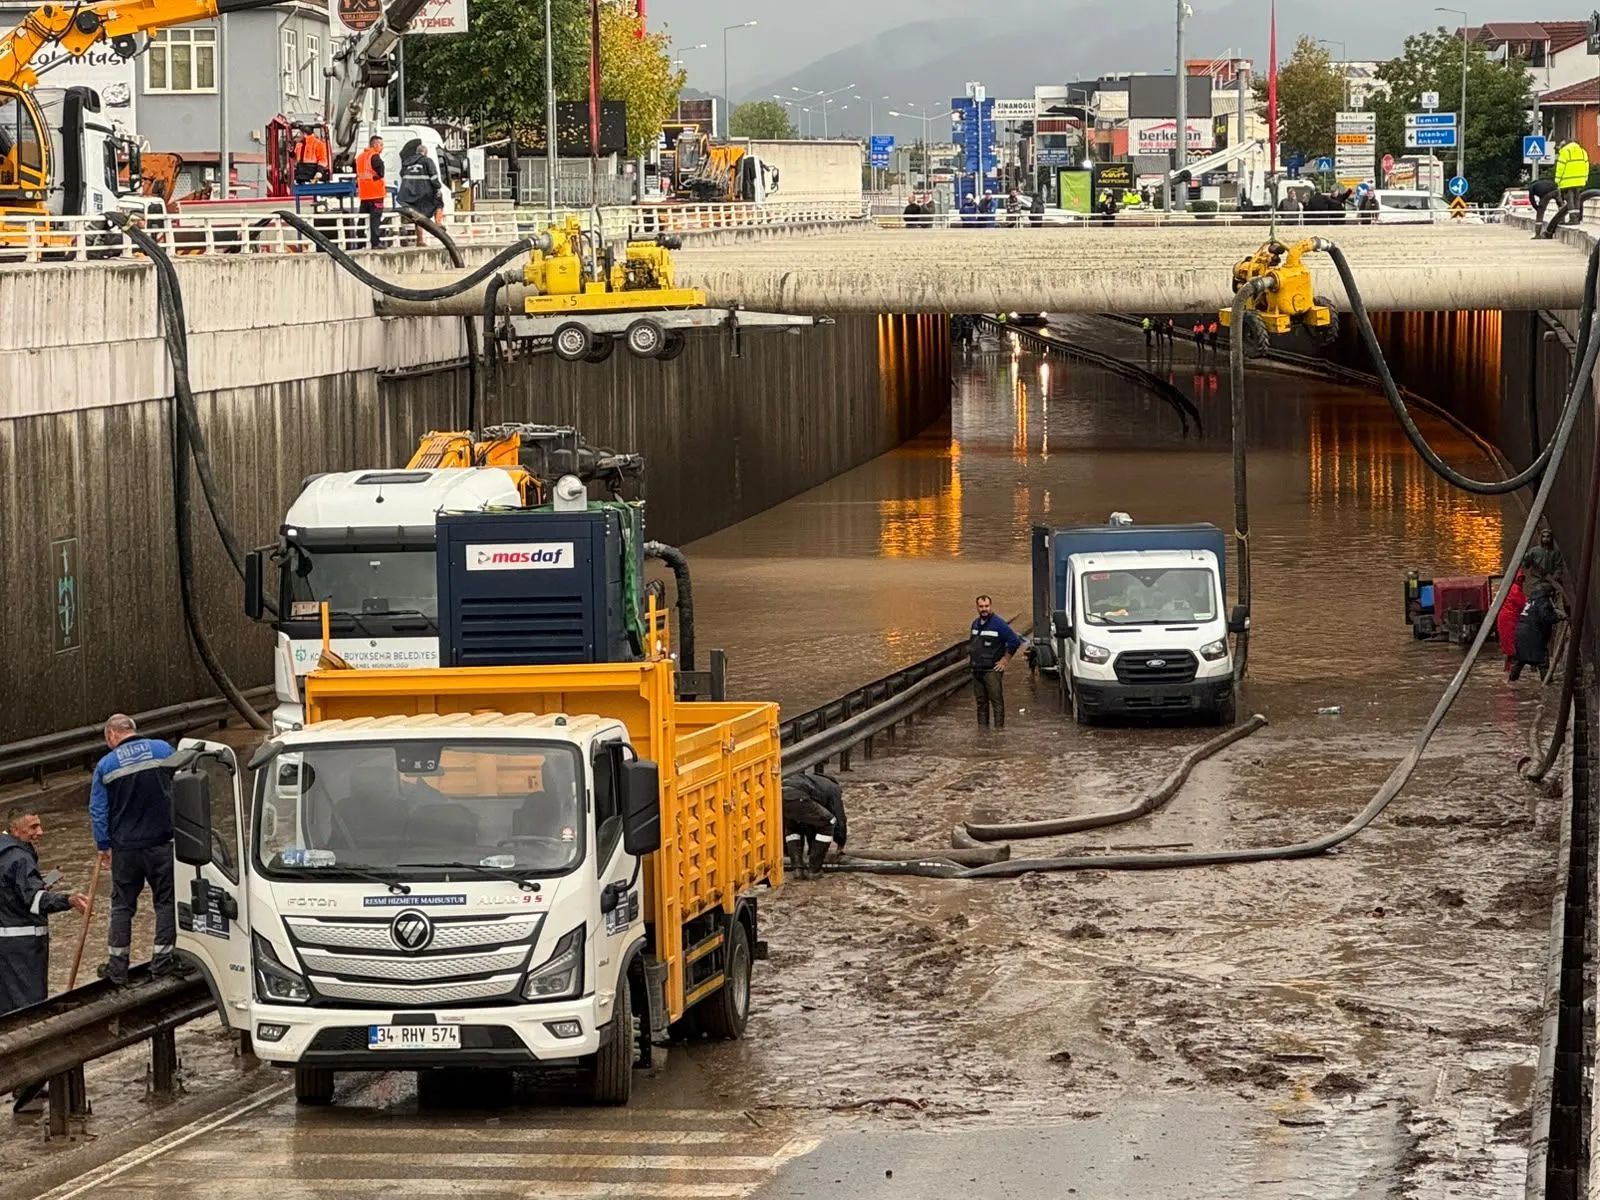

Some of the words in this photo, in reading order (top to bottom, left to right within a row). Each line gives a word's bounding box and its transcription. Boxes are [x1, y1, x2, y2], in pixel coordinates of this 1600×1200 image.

[420, 17, 455, 28] YEMEK
[1139, 130, 1201, 141] berkean
[491, 548, 563, 564] masdaf
[378, 1028, 394, 1042] 34
[402, 1028, 426, 1042] RHV
[432, 1027, 456, 1042] 574
